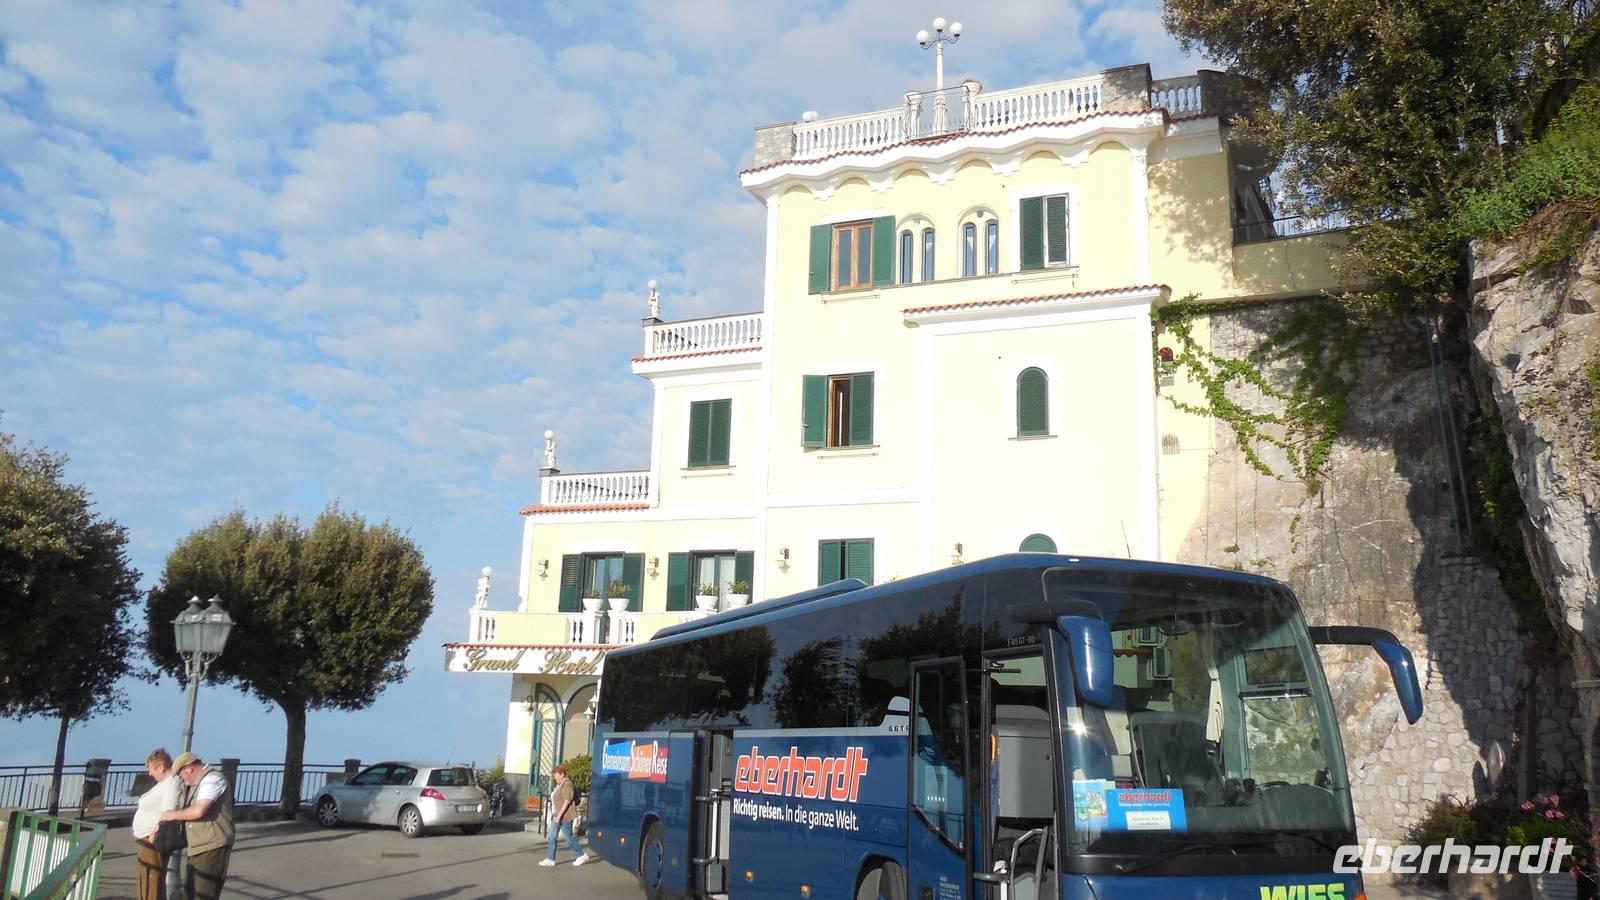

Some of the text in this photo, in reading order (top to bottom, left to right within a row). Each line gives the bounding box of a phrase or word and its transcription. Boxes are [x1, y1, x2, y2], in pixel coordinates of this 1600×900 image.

[463, 649, 605, 674] Grand Hotel
[734, 746, 868, 803] eberhardt
[733, 798, 859, 831] Richtig reisen. In die ganze Welt.
